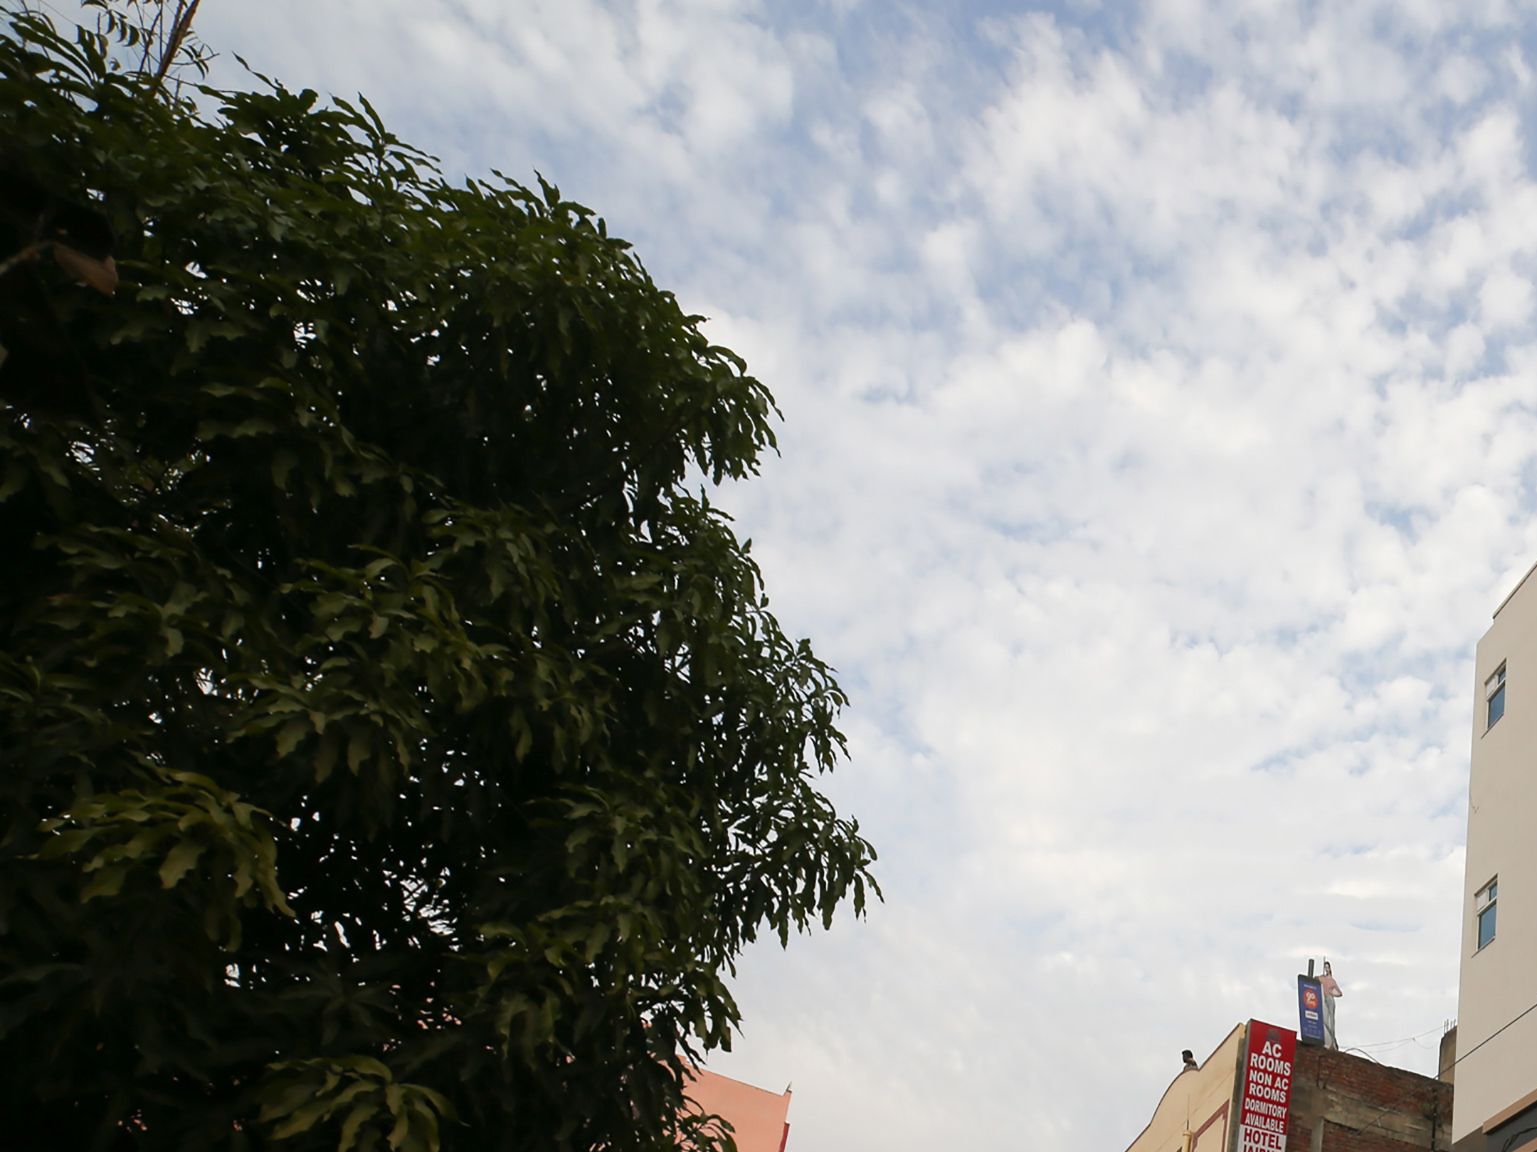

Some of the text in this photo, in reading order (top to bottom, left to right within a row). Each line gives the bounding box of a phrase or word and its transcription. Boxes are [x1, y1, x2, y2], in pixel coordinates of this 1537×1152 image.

[1262, 1041, 1282, 1058] AC
[1251, 1053, 1291, 1076] ROOMS
[1249, 1069, 1289, 1091] NON AC
[1249, 1083, 1286, 1104] ROOMS
[1244, 1097, 1287, 1119] DORMITORY
[1244, 1113, 1284, 1133] AVAILABLE
[1243, 1128, 1282, 1150] HOTEL
